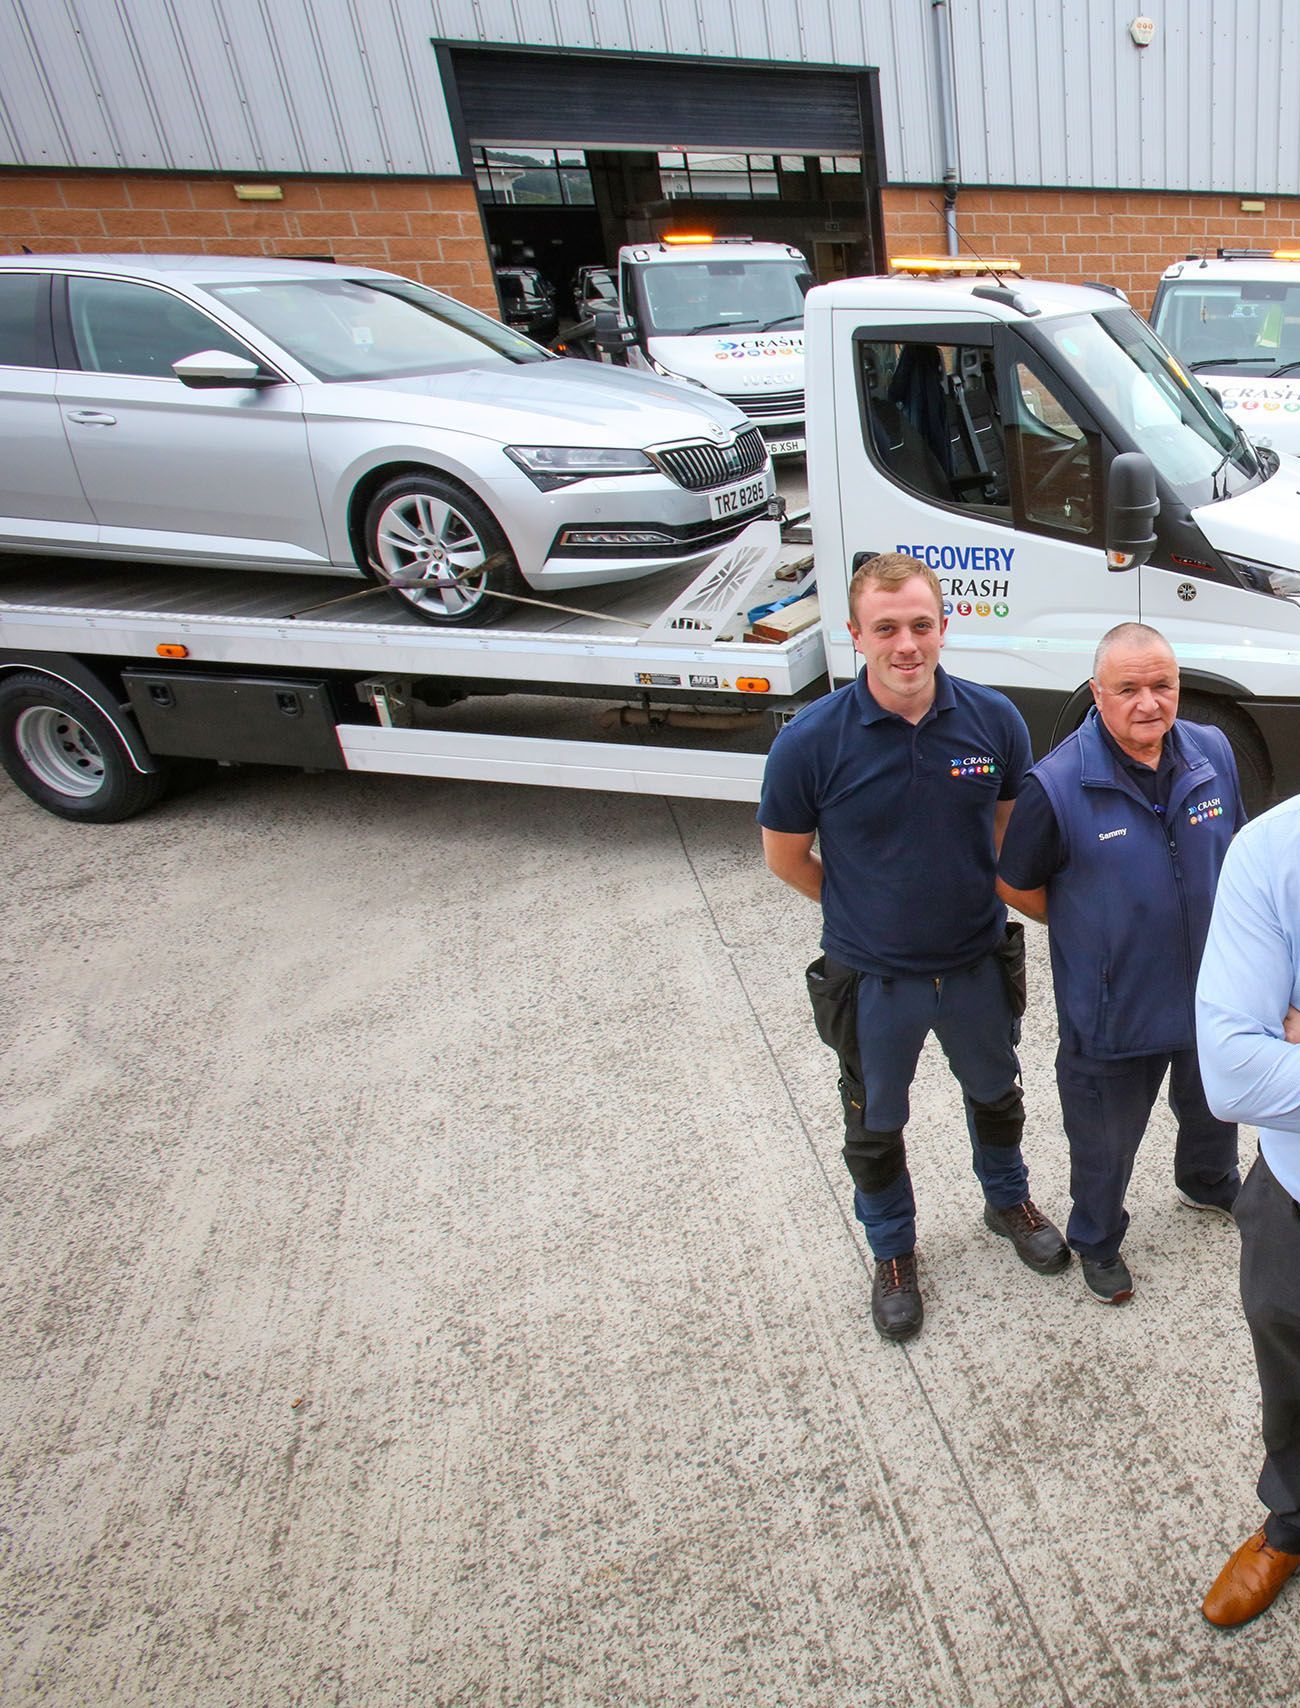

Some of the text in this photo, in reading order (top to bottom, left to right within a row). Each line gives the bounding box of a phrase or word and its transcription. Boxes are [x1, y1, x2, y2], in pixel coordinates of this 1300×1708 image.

[741, 338, 803, 349] CRASH
[743, 374, 796, 386] IVECO
[780, 440, 799, 452] XSH
[715, 481, 764, 515] TRZ 8285
[963, 757, 994, 765] CRASH
[1197, 797, 1221, 812] CRASH
[1099, 827, 1127, 841] Sammy
